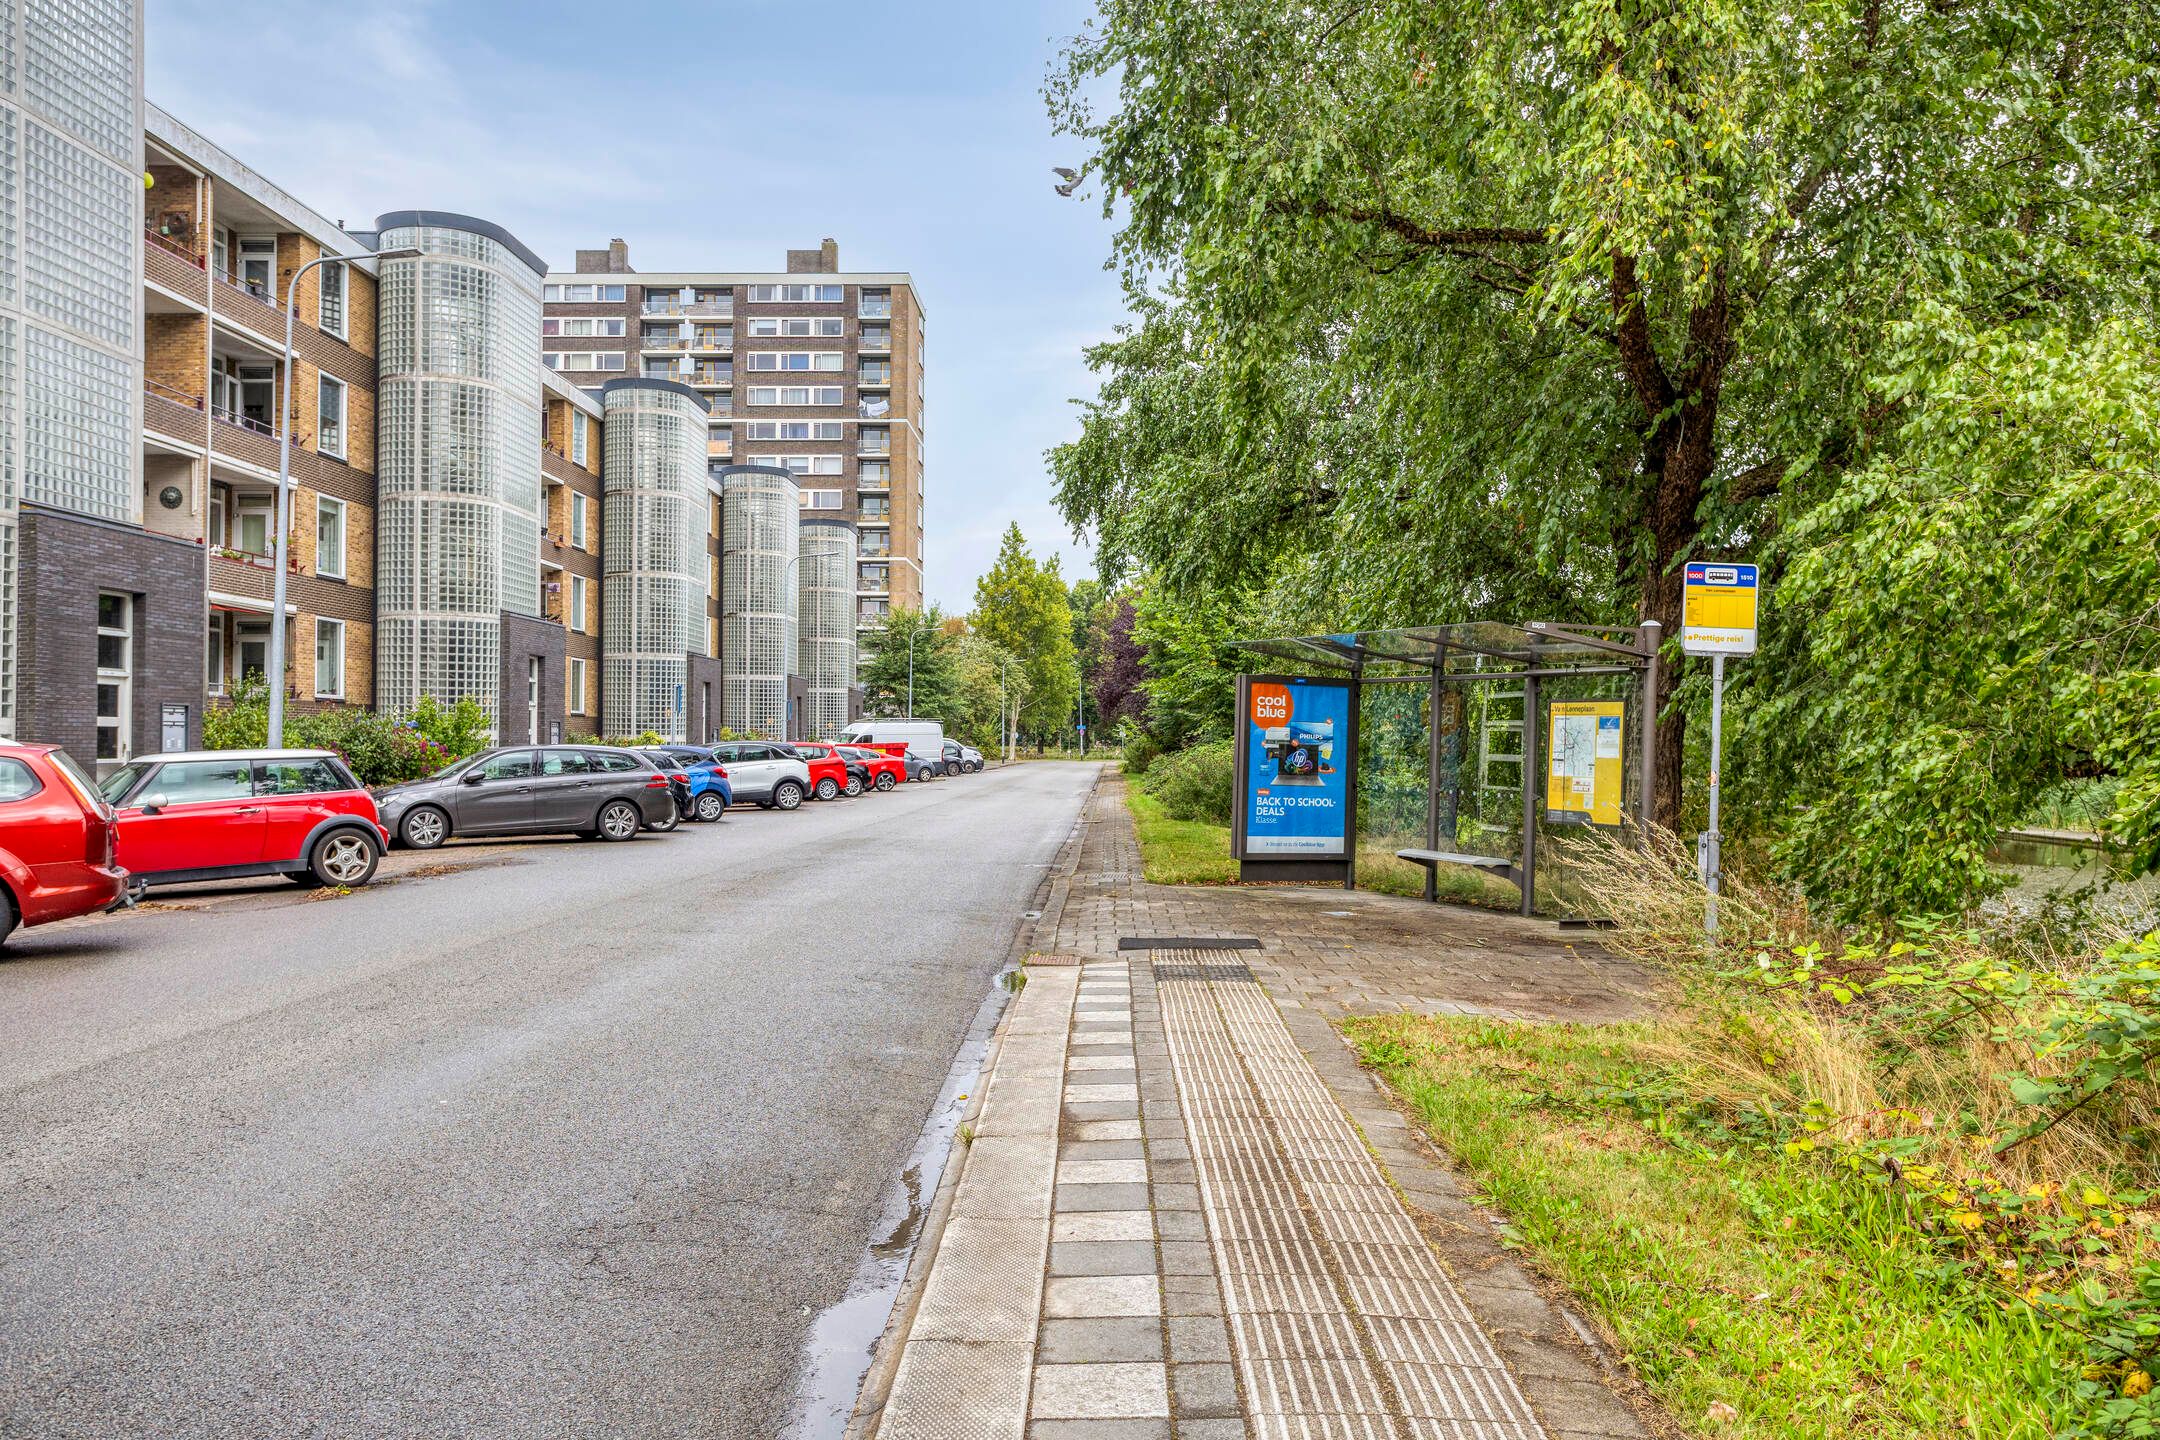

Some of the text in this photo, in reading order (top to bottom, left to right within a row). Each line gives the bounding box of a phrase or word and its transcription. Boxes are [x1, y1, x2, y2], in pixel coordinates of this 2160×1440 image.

[1693, 633, 1725, 643] Prettige
[1257, 695, 1286, 706] cool
[1256, 705, 1286, 718] blue
[1256, 797, 1281, 806] BACK
[1283, 797, 1296, 807] TO
[1256, 806, 1285, 816] DEALS
